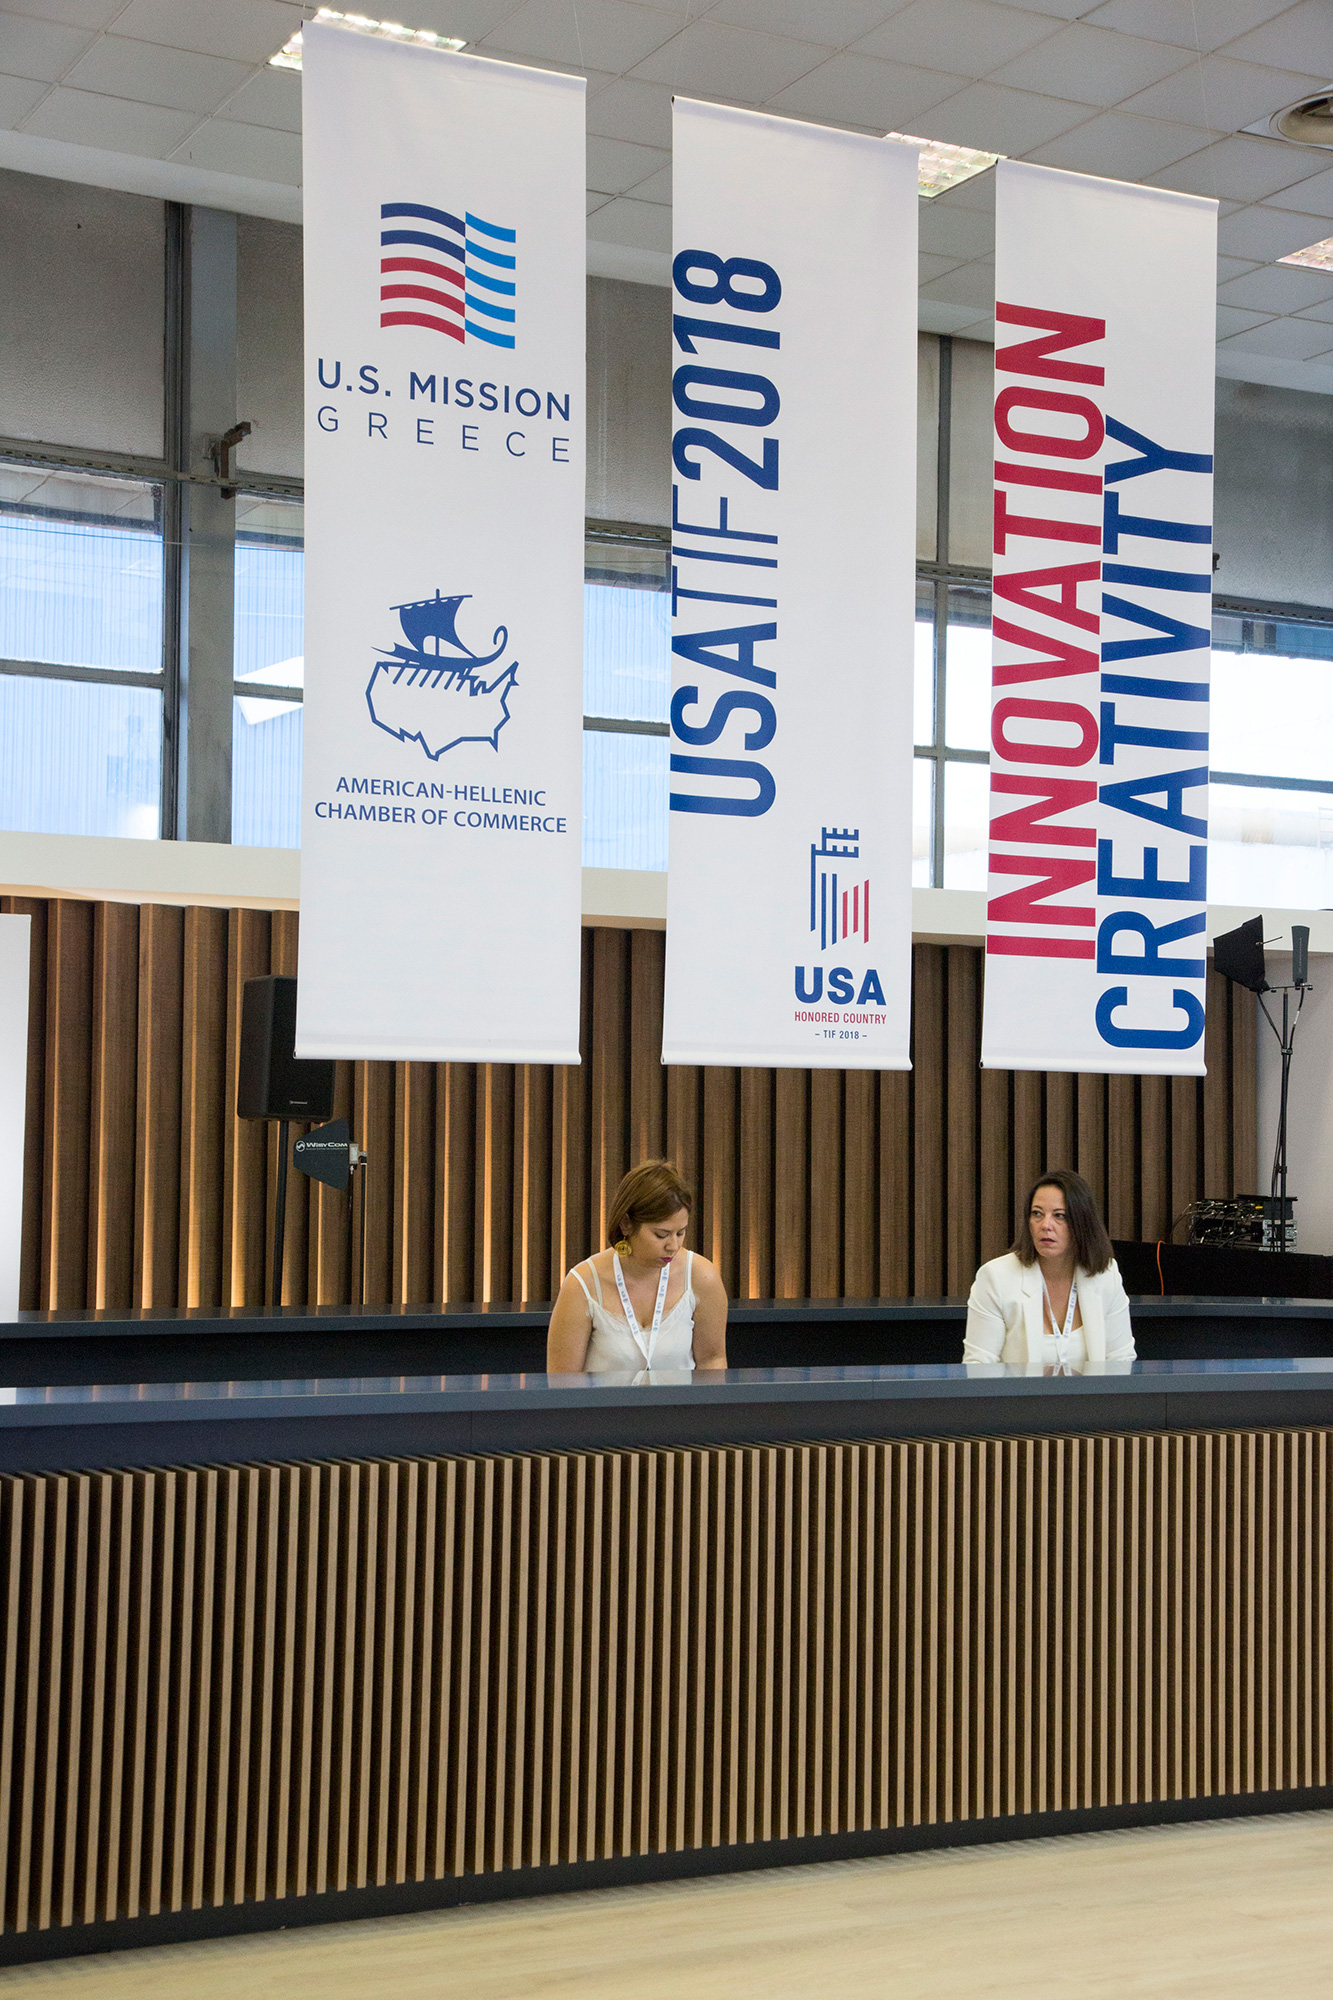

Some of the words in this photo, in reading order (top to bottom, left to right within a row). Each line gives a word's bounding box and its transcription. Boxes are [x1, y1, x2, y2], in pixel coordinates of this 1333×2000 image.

[318, 358, 391, 396] U.S.
[410, 371, 570, 421] MISSION
[317, 405, 570, 463] GREECE
[670, 249, 782, 817] USATIF2018
[986, 300, 1106, 960] INNOVATION
[1095, 413, 1214, 1050] CREATIVITY
[336, 777, 546, 807] AMERICAN-HELLENIC
[314, 802, 416, 824] CHAMBER
[421, 809, 448, 826] OF
[453, 811, 567, 833] COMMERCE
[794, 965, 887, 1006] USA
[794, 1011, 840, 1023] HONORED
[843, 1012, 887, 1025] COUNTRY
[823, 1030, 836, 1039] TIF
[839, 1030, 860, 1040] 2018
